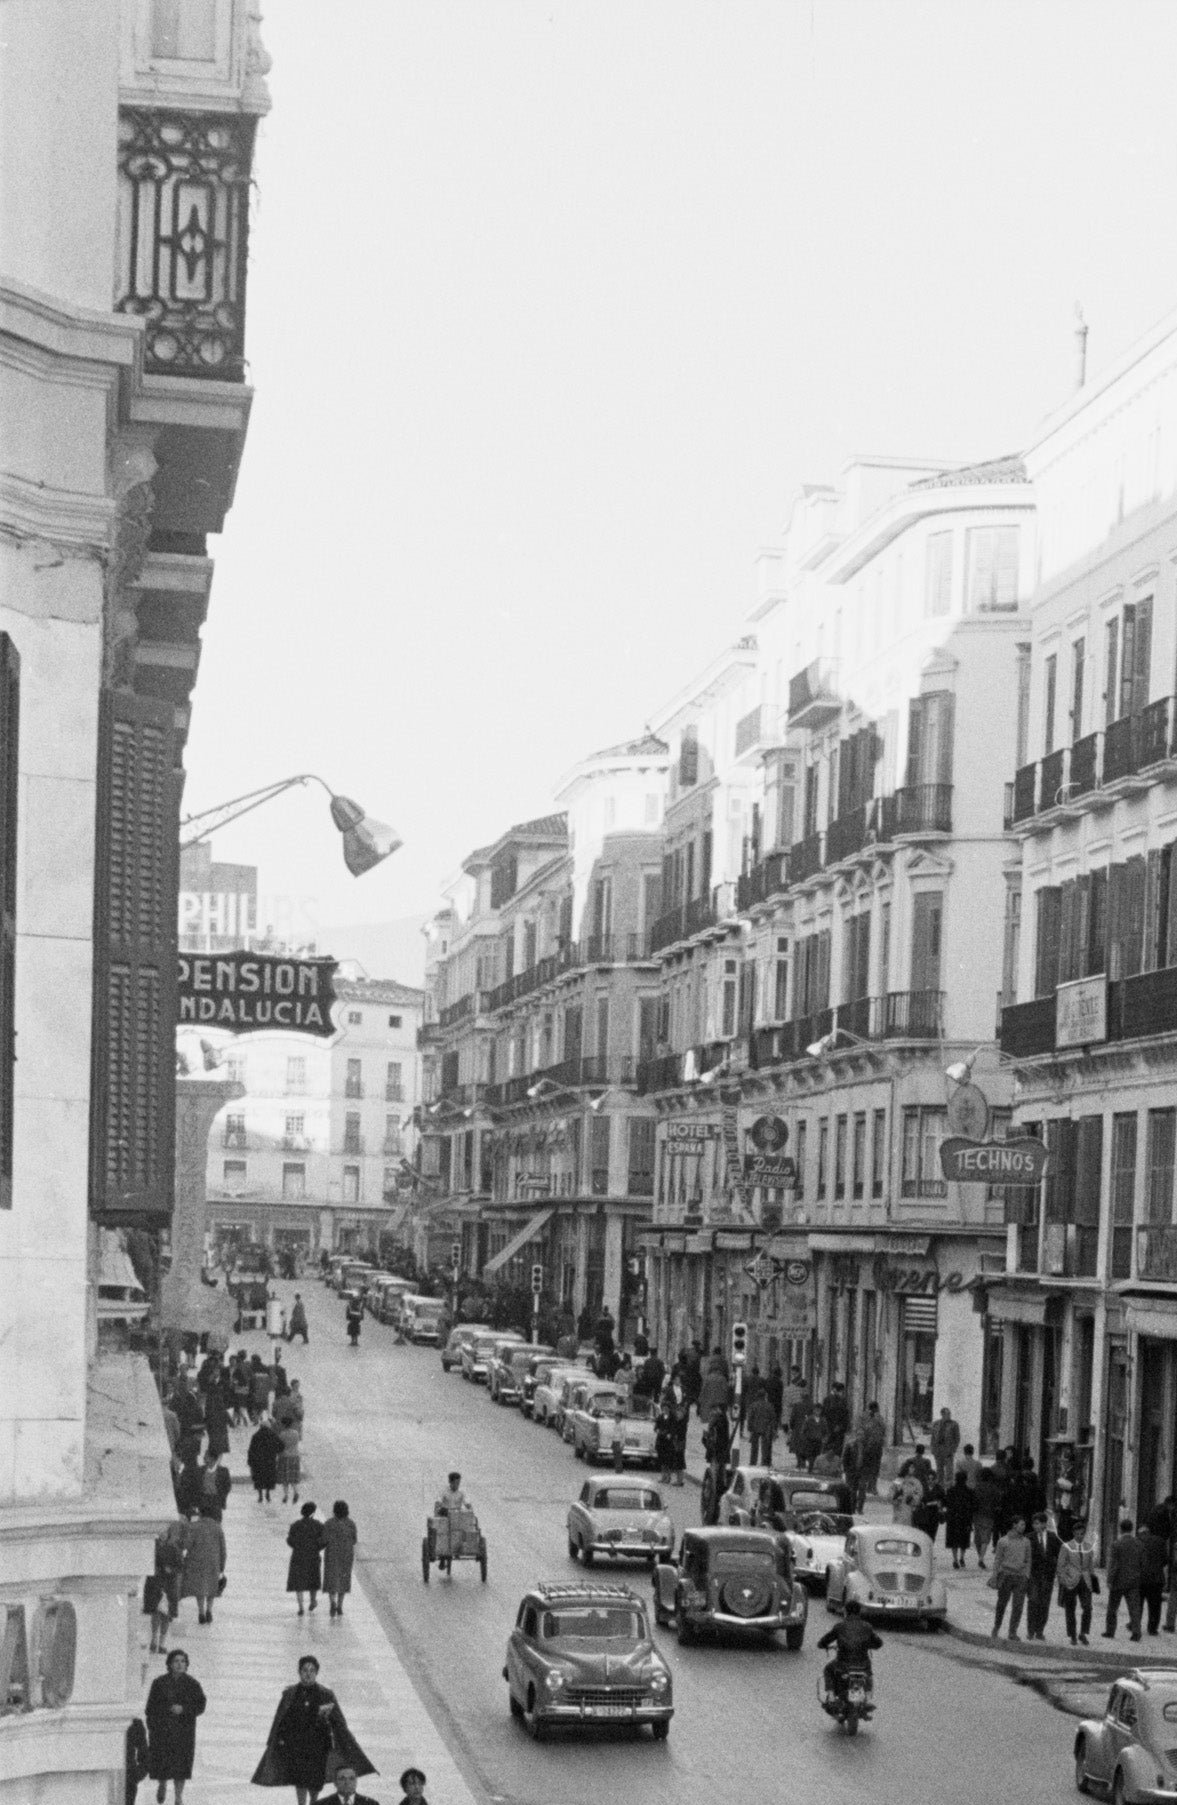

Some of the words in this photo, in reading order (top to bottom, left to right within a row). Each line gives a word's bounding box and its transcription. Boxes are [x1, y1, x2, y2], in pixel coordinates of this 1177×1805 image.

[177, 959, 318, 995] PENSION
[180, 996, 323, 1025] NDALUCIA
[669, 1124, 711, 1138] HOTEL
[954, 1150, 1035, 1172] TECHNOS
